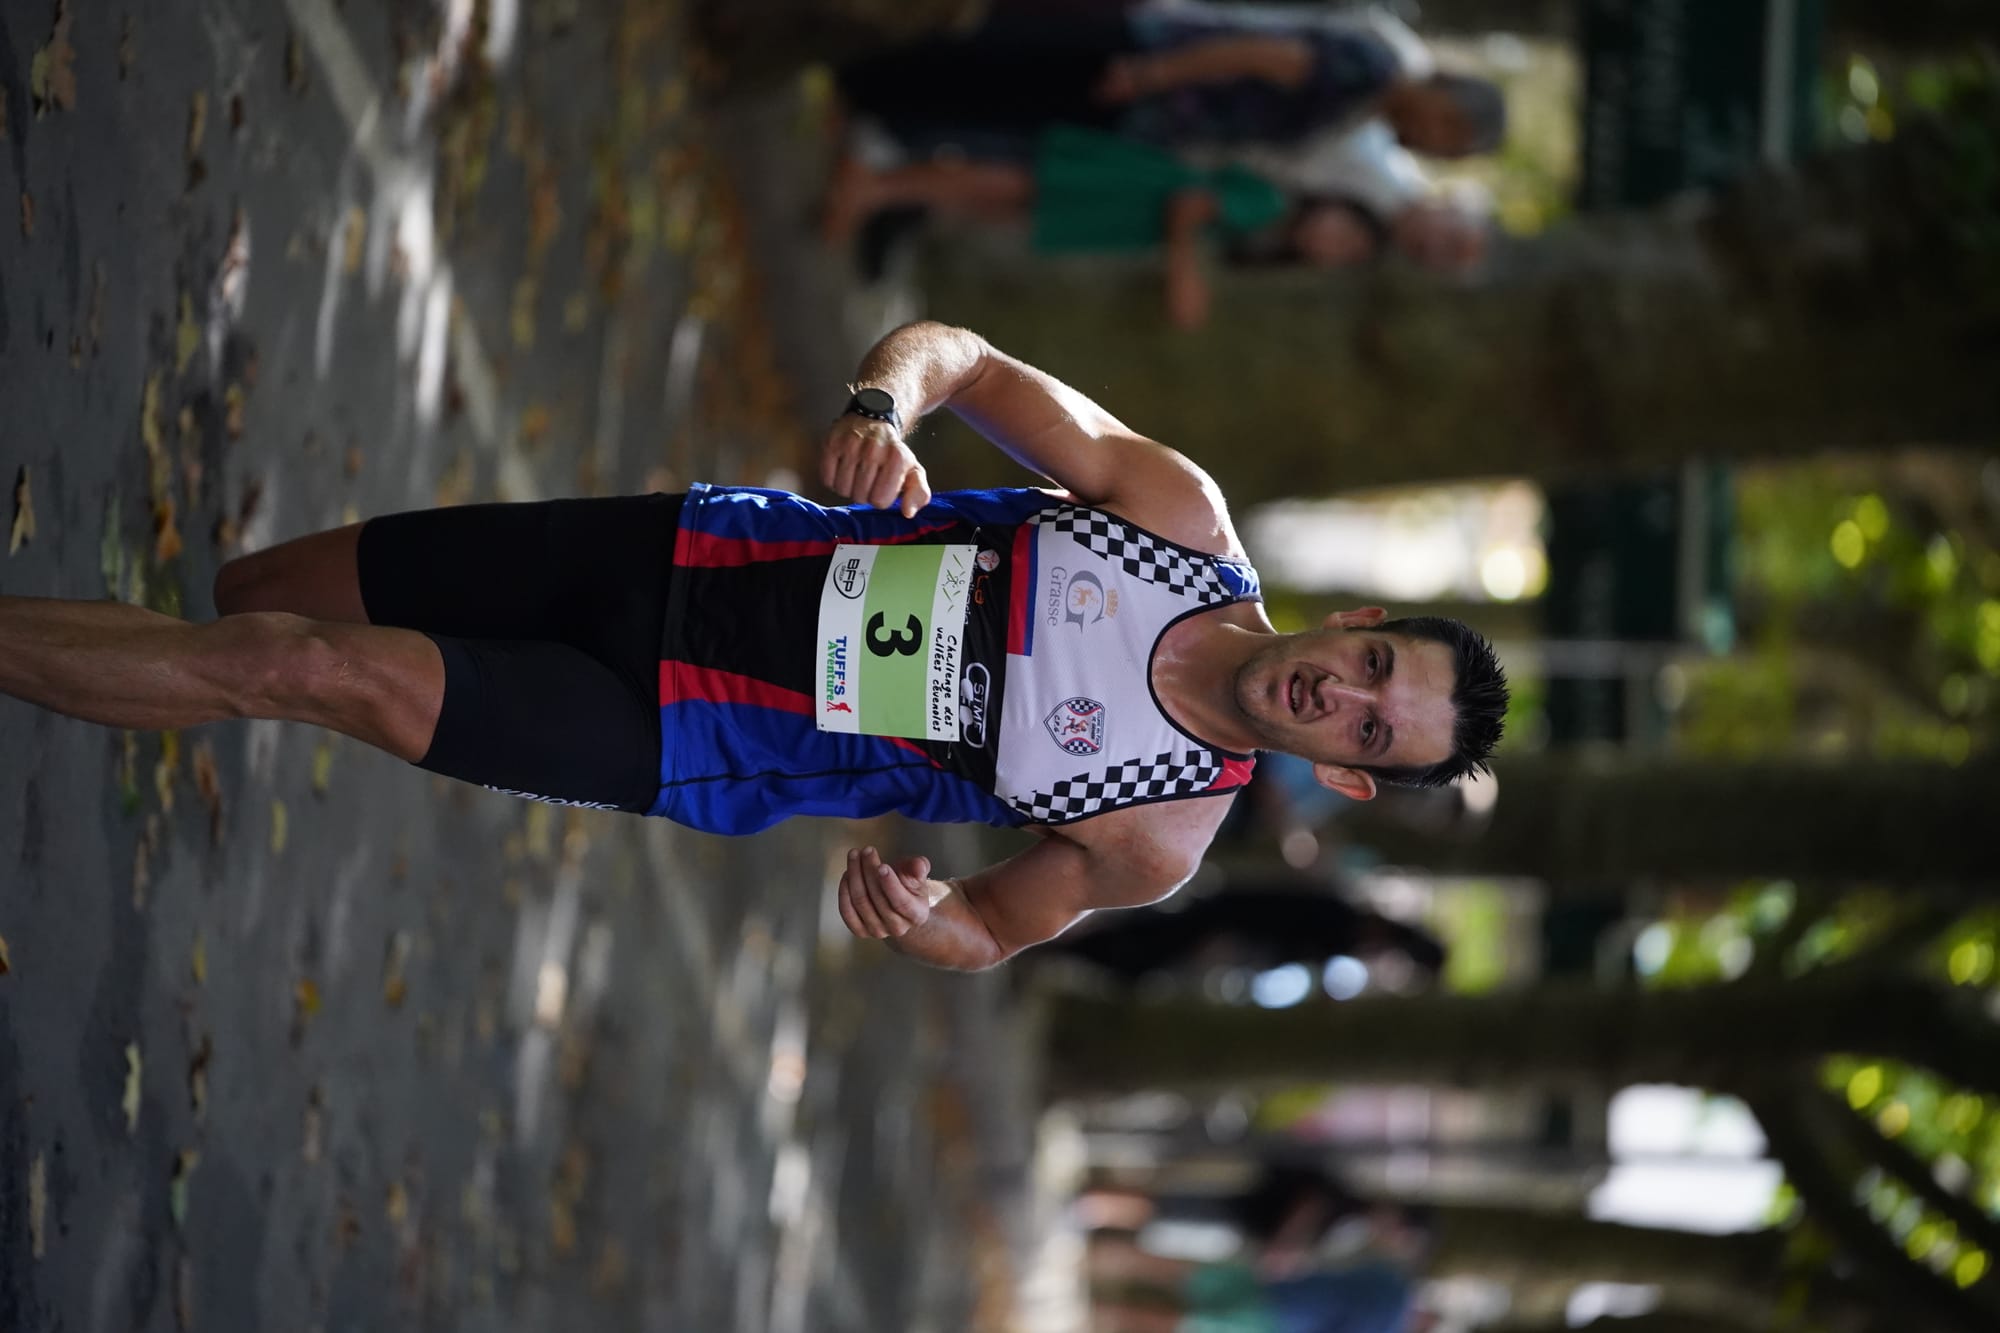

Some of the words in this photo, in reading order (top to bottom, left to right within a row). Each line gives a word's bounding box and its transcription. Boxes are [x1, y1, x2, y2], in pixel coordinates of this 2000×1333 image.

[842, 558, 861, 592] BFP
[1047, 566, 1067, 627] Grasse
[865, 611, 923, 657] 3
[934, 627, 945, 672] vallées
[826, 640, 838, 701] Aventure
[834, 636, 847, 696] TUFF'S
[941, 635, 957, 699] Challenge
[932, 679, 942, 732] cévenoles
[944, 706, 954, 727] des
